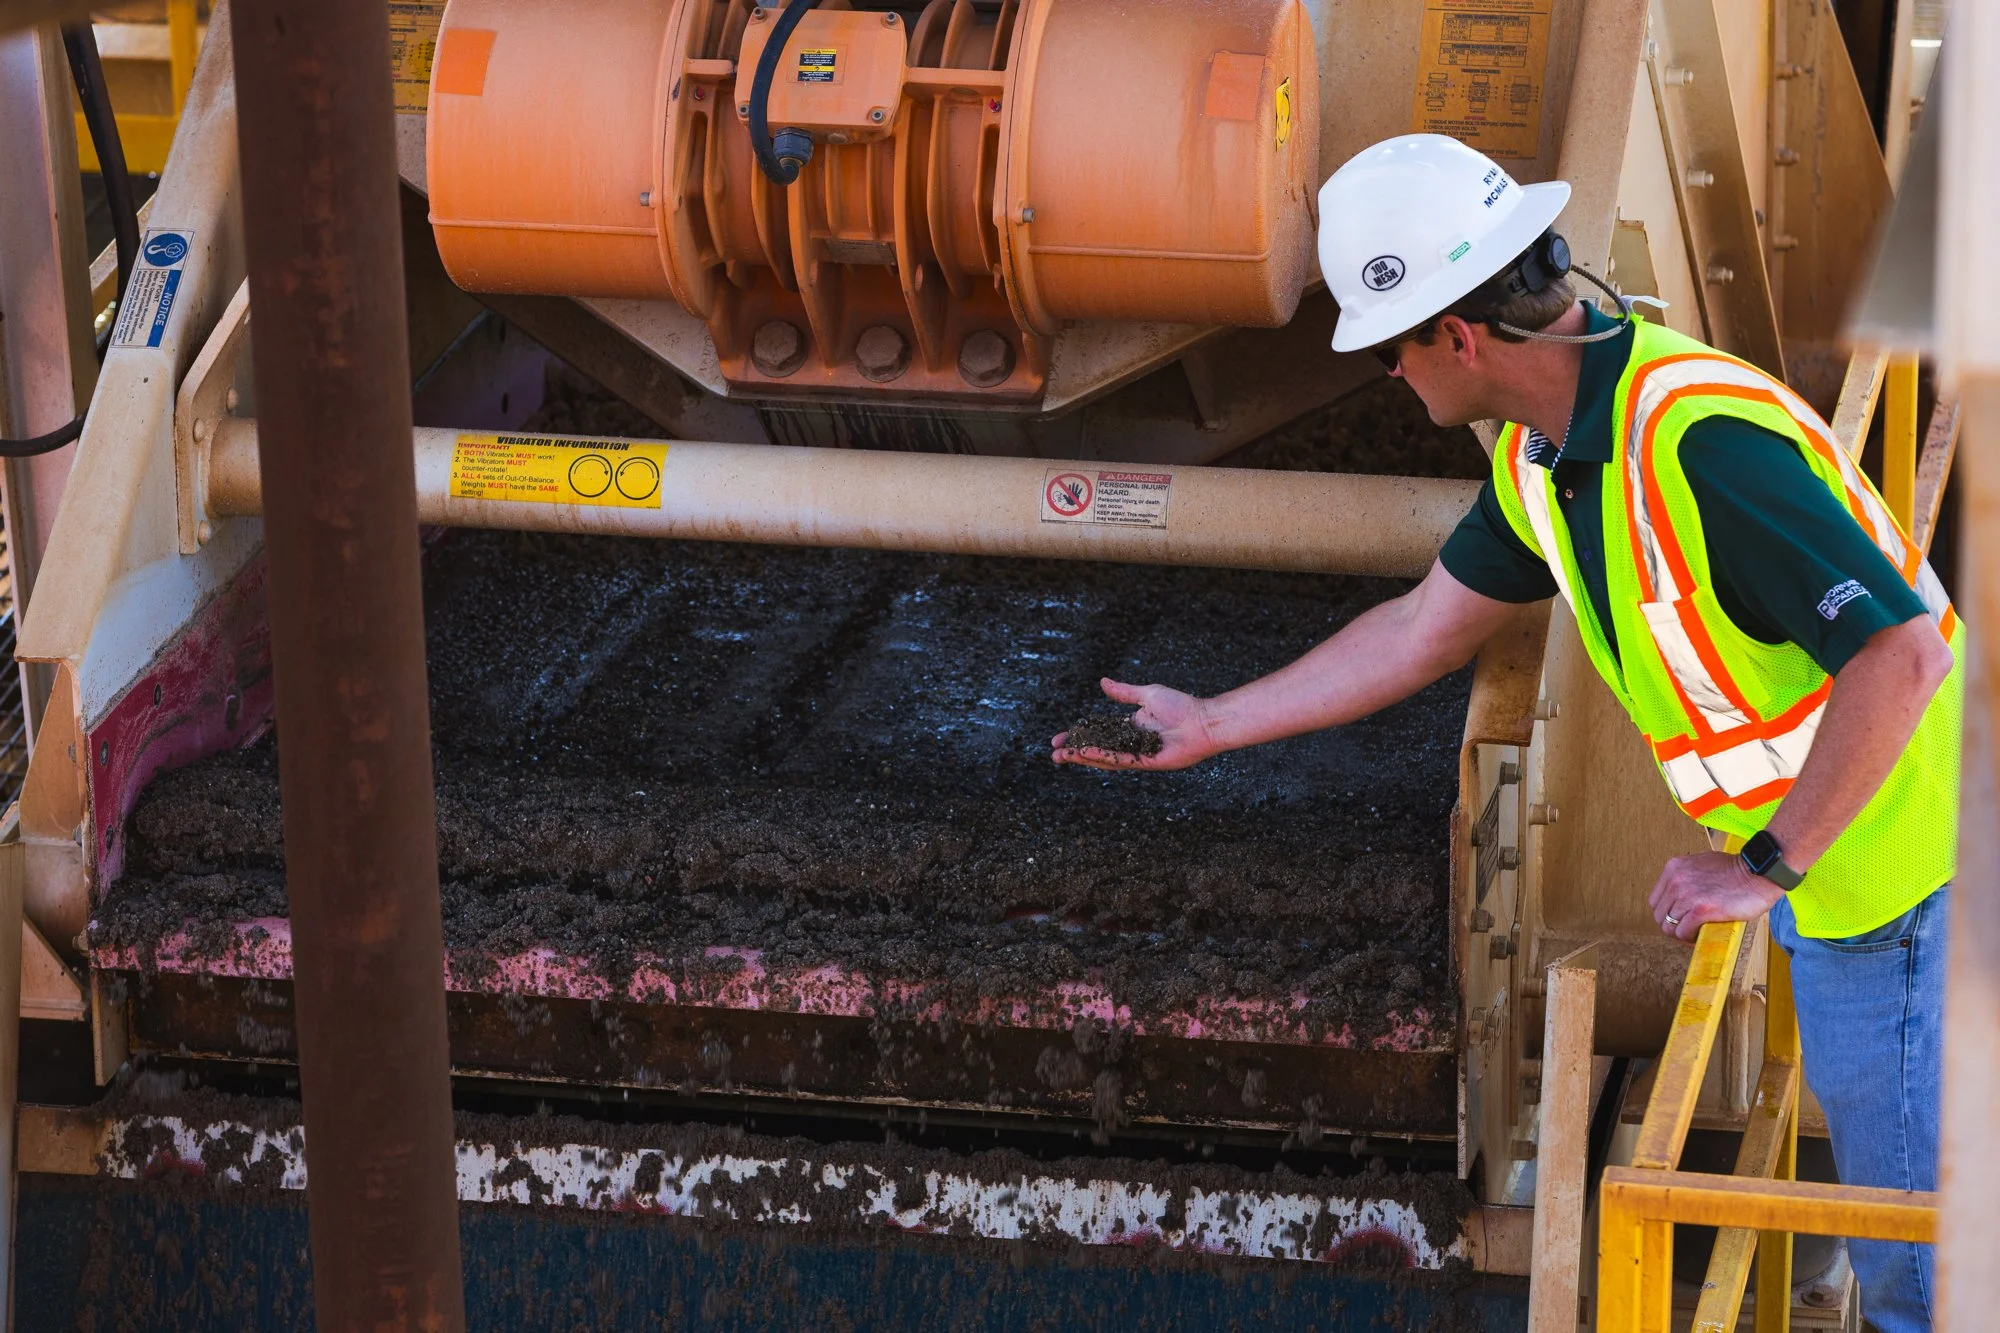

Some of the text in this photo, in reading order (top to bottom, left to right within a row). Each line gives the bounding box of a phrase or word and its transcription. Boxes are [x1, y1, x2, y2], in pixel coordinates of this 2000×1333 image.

[1371, 260, 1388, 275] 100
[159, 271, 167, 282] LIFT
[1373, 268, 1399, 287] MESH
[155, 292, 173, 325] NOTICE
[497, 436, 629, 450] VIBRATOR INFORMATION
[505, 475, 554, 483] Out-Of-Balance
